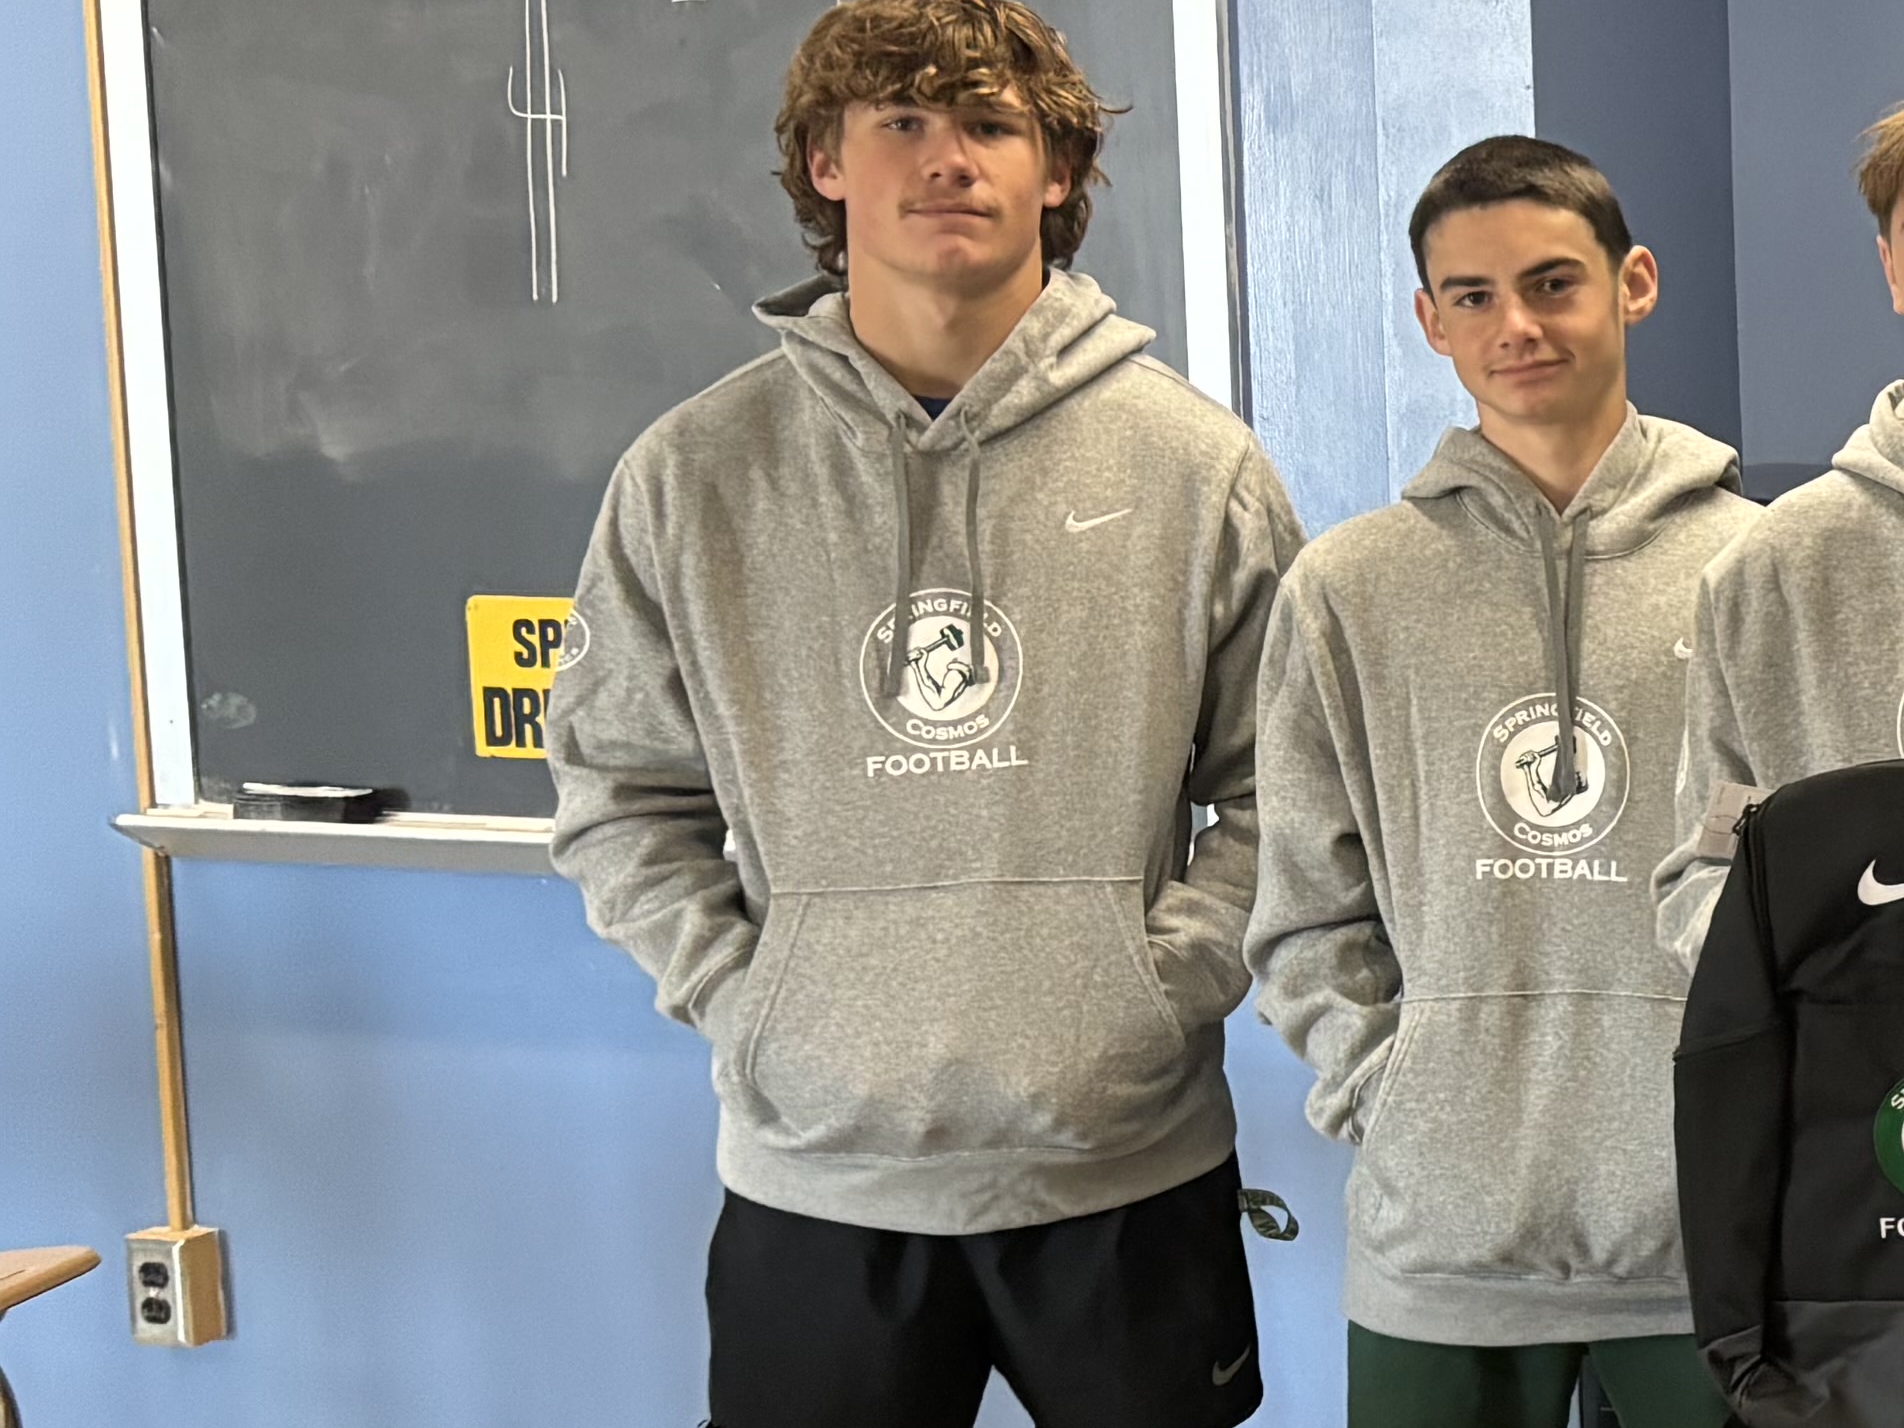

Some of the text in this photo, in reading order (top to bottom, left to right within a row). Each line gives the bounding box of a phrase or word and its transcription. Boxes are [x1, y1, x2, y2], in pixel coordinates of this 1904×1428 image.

[511, 618, 570, 669] SP
[865, 744, 1030, 778] FOOTBALL
[1475, 857, 1628, 883] FOOTBALL
